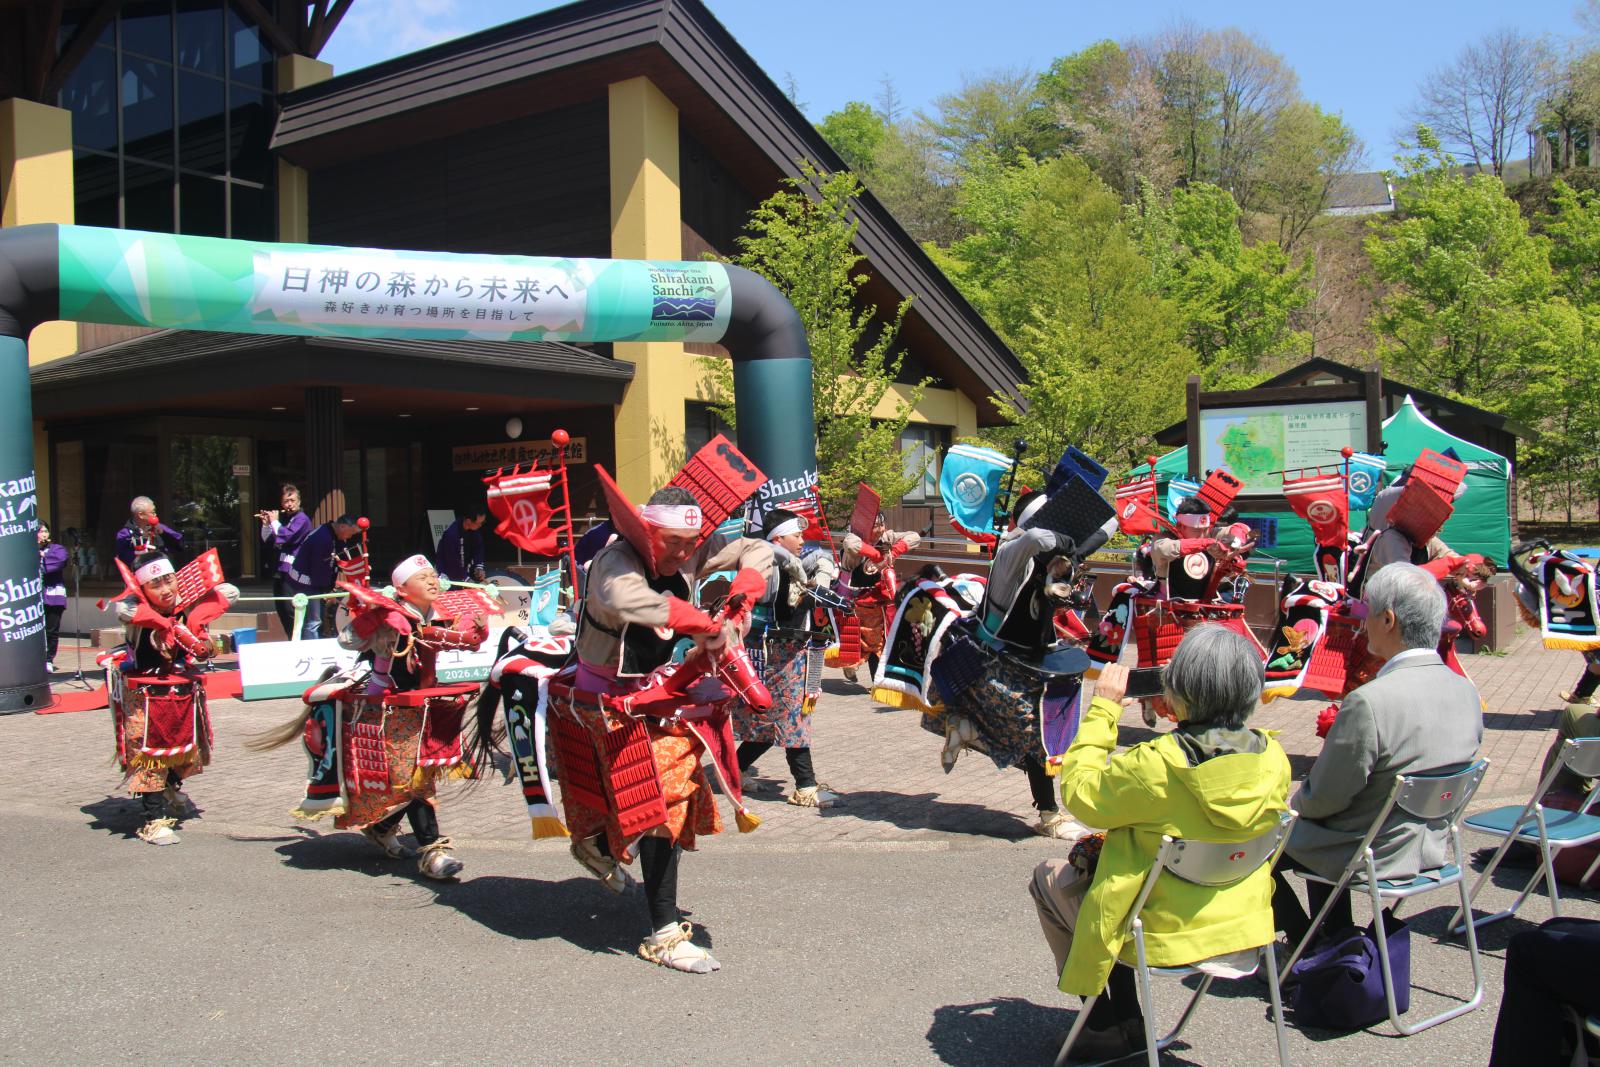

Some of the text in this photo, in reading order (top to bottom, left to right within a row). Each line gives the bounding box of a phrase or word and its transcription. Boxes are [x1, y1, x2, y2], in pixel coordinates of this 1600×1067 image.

[650, 272, 714, 285] Shirakami
[652, 285, 694, 297] Sanchi
[323, 300, 536, 323] 森好きが育つ場所を目指して
